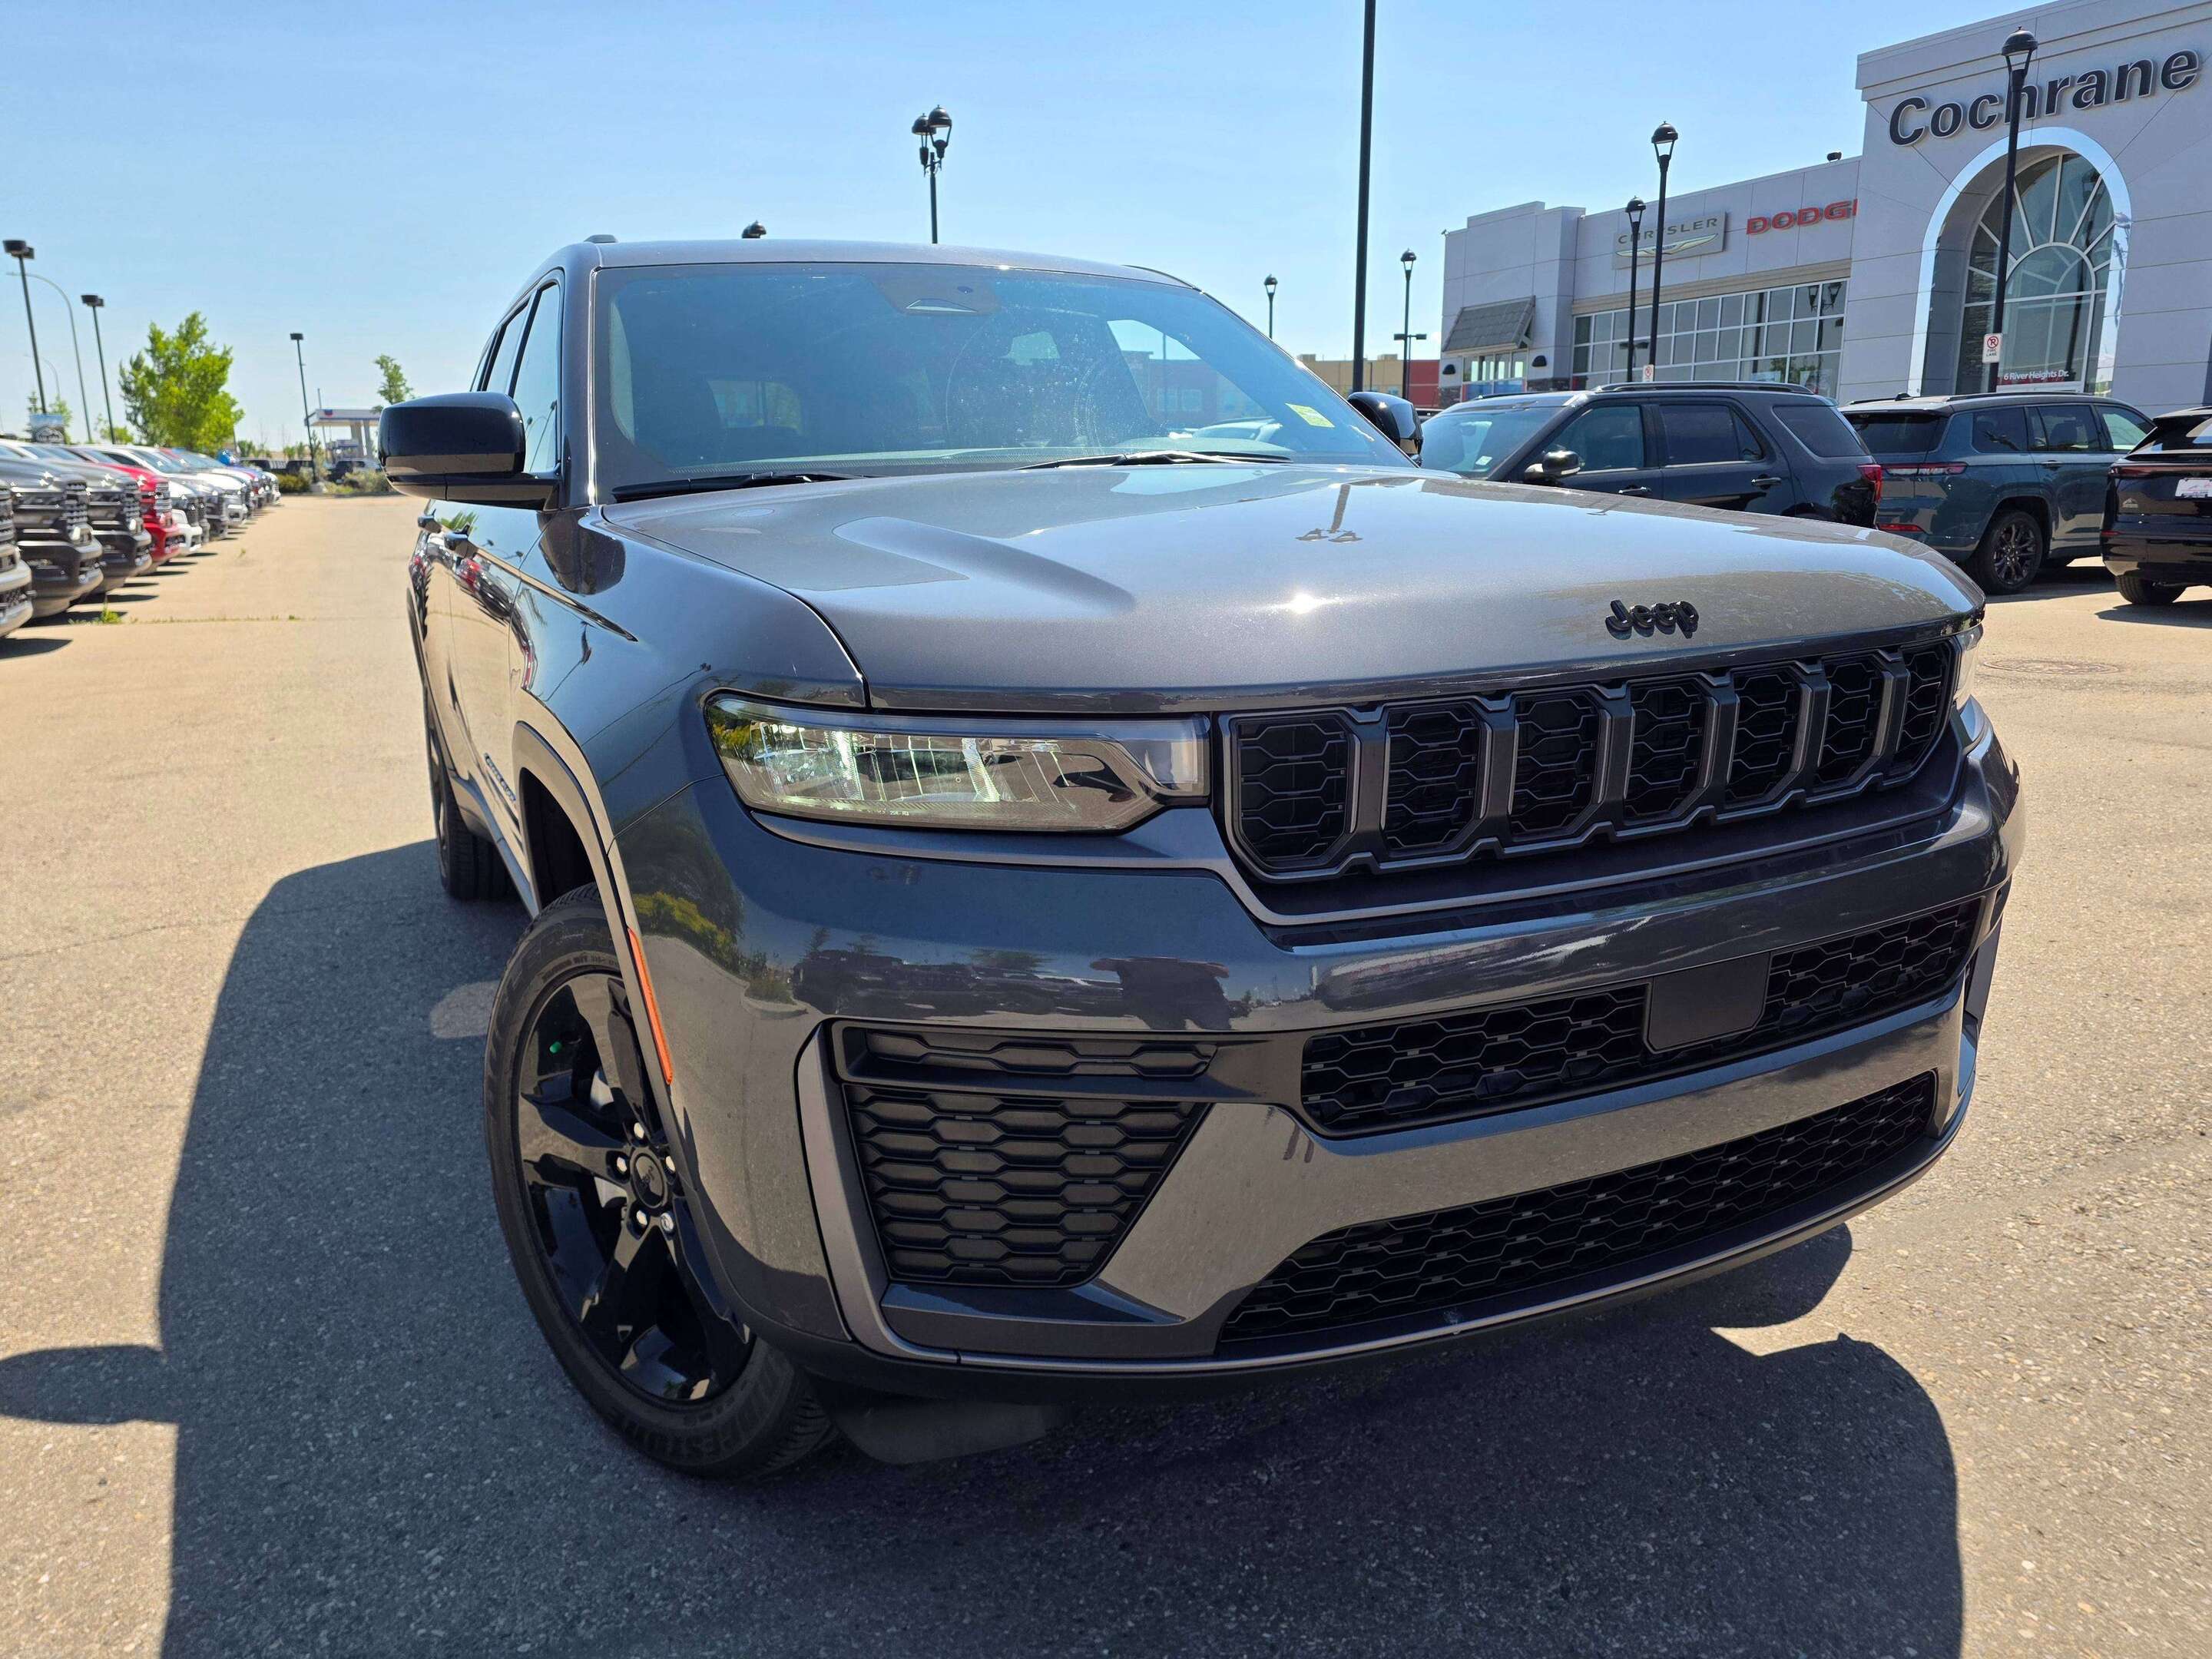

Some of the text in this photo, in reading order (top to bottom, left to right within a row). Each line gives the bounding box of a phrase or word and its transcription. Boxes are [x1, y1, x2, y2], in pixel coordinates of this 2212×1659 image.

[1888, 48, 2200, 147] Cochrane
[1618, 217, 1718, 244] CHRSLER
[2003, 369, 2069, 381] 6 River Heights Dr.
[1604, 599, 1700, 640] Jeep
